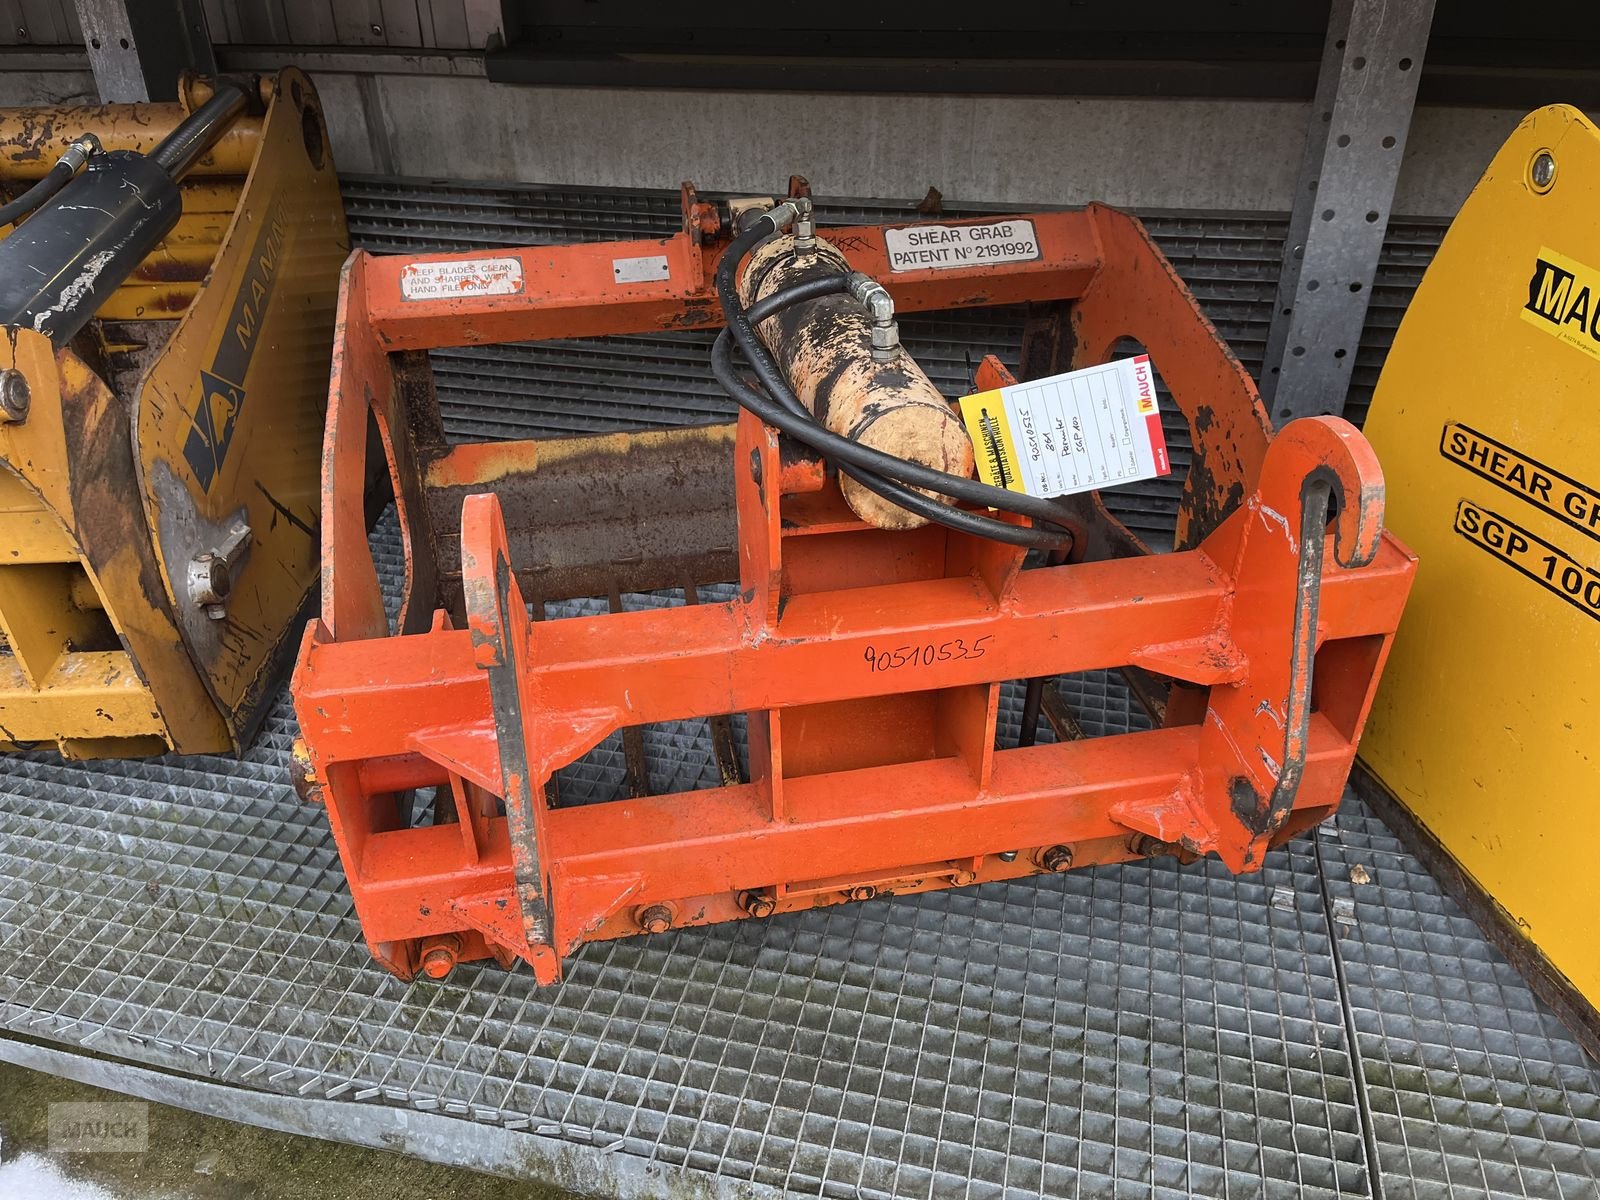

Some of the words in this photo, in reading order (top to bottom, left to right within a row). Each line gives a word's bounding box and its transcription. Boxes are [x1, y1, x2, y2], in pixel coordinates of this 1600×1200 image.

[908, 229, 962, 246] SHEAR
[969, 225, 1014, 241] GRAB
[893, 247, 950, 265] PATENT
[976, 241, 1034, 258] 2191992
[410, 277, 431, 286] AND
[434, 274, 480, 285] SHARPEN
[439, 265, 476, 275] BLADES
[481, 263, 513, 273] CLEAN
[410, 285, 437, 294] HAND
[442, 284, 461, 292] FILE
[1135, 366, 1154, 409] MAUCH
[978, 418, 996, 457] MASCHINEN
[1073, 433, 1086, 454] SGP
[1450, 432, 1552, 503] SHEAR
[1461, 507, 1528, 557] SGP
[1542, 555, 1600, 610] 100
[864, 634, 993, 672] 90510535
